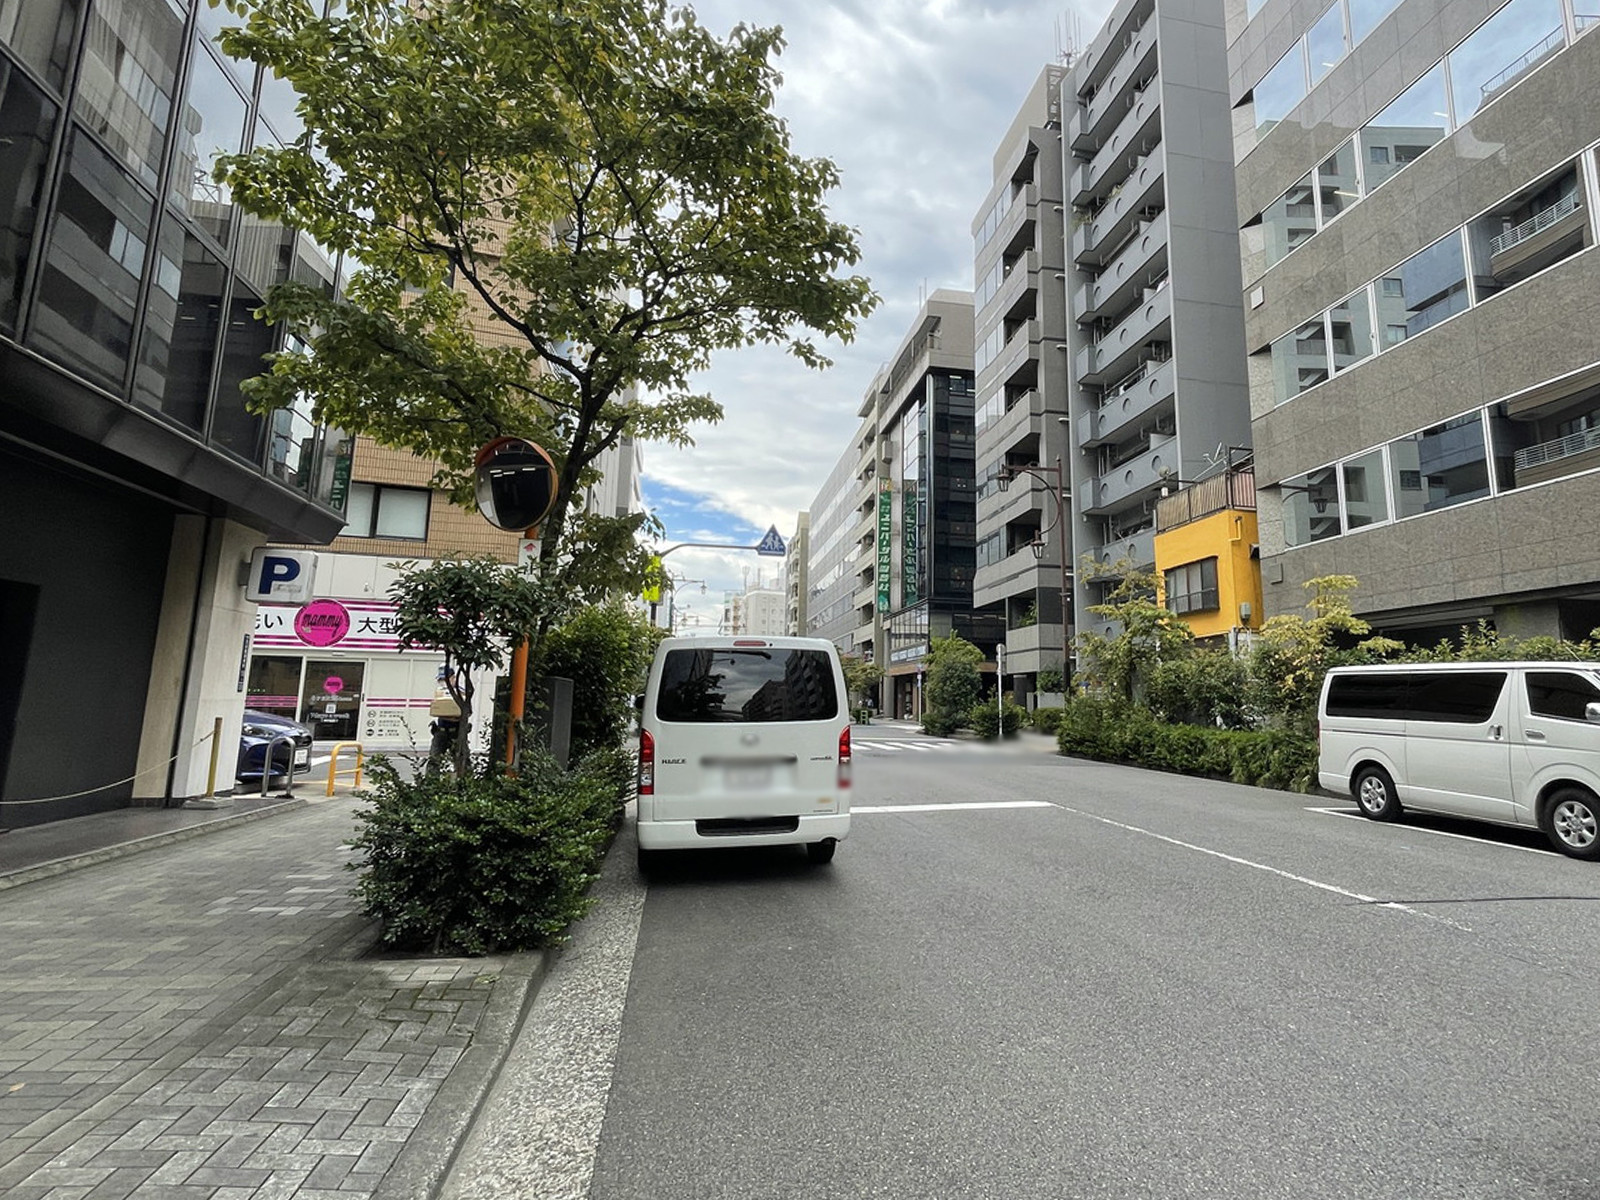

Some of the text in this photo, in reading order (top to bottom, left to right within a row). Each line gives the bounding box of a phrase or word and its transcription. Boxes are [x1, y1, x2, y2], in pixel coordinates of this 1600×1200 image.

[258, 556, 300, 594] P
[302, 614, 343, 638] mammy
[357, 616, 402, 635] 大型
